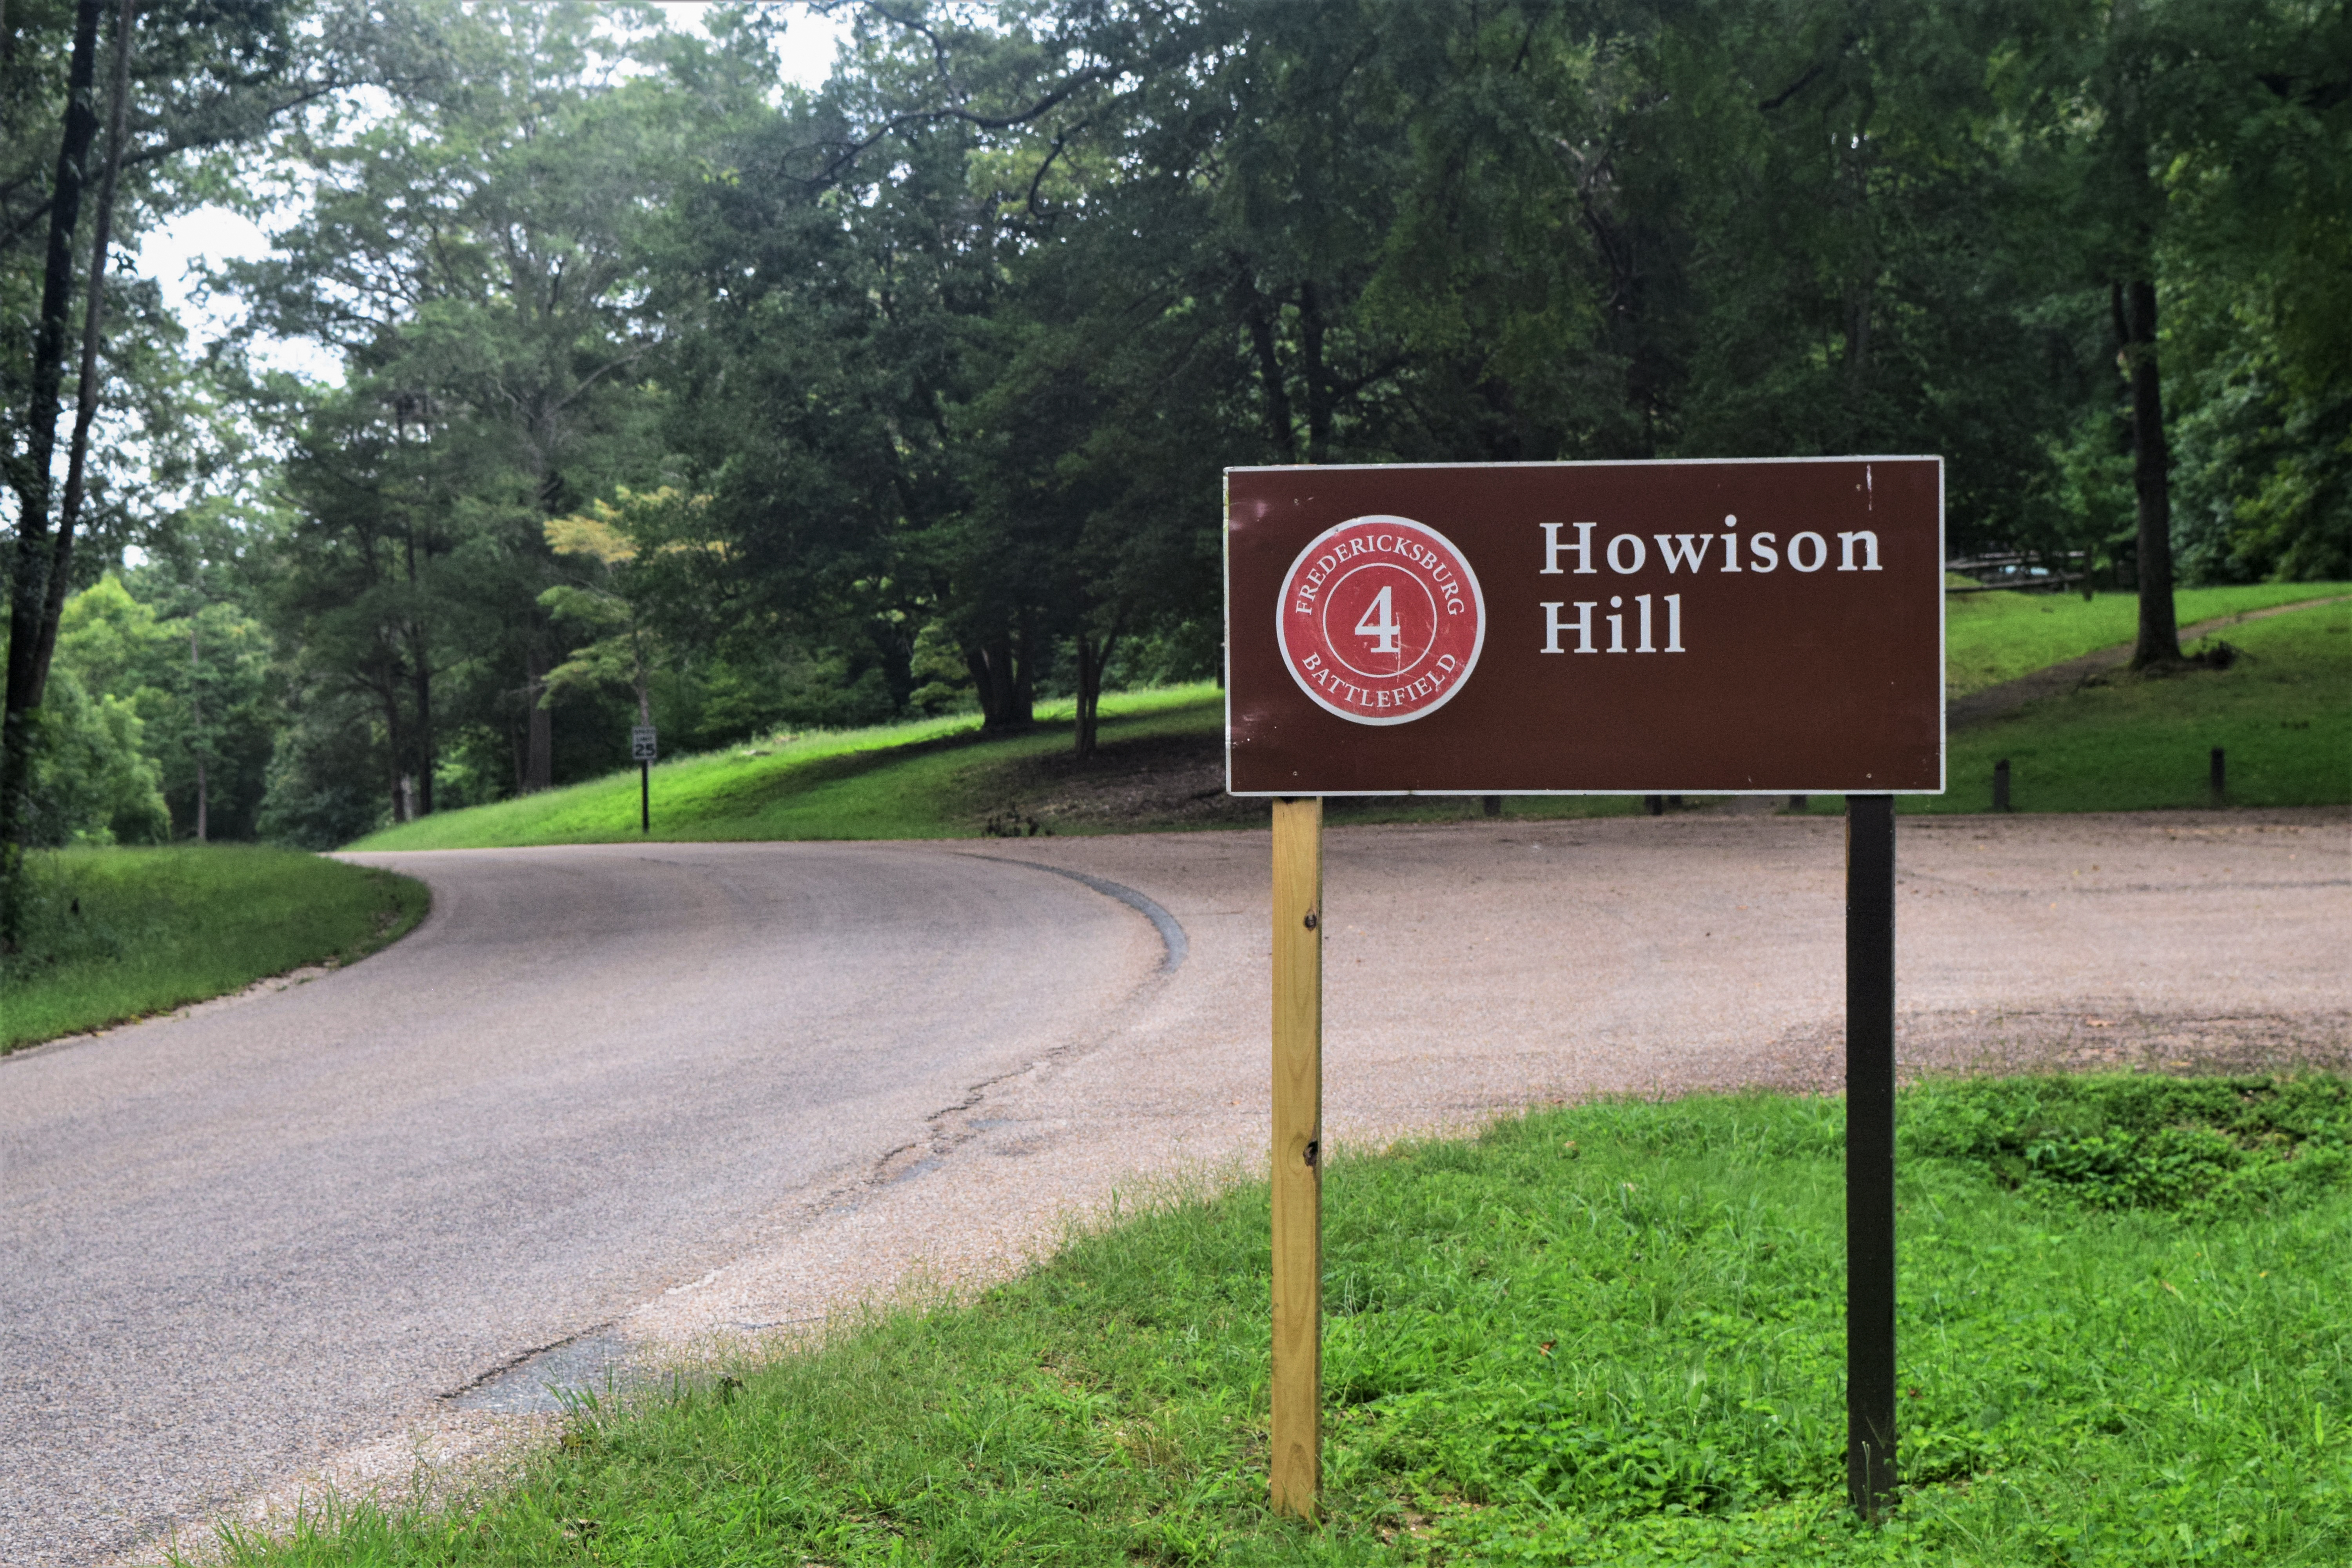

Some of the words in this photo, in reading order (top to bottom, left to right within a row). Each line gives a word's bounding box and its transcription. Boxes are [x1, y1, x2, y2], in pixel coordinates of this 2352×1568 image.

[1539, 514, 1883, 574] Howison
[1296, 534, 1465, 615] FREDERICKSBURG
[1354, 586, 1401, 653] 4
[1539, 594, 1686, 654] Hill
[1302, 652, 1456, 708] BATTLEFIELD
[635, 743, 655, 756] 25
